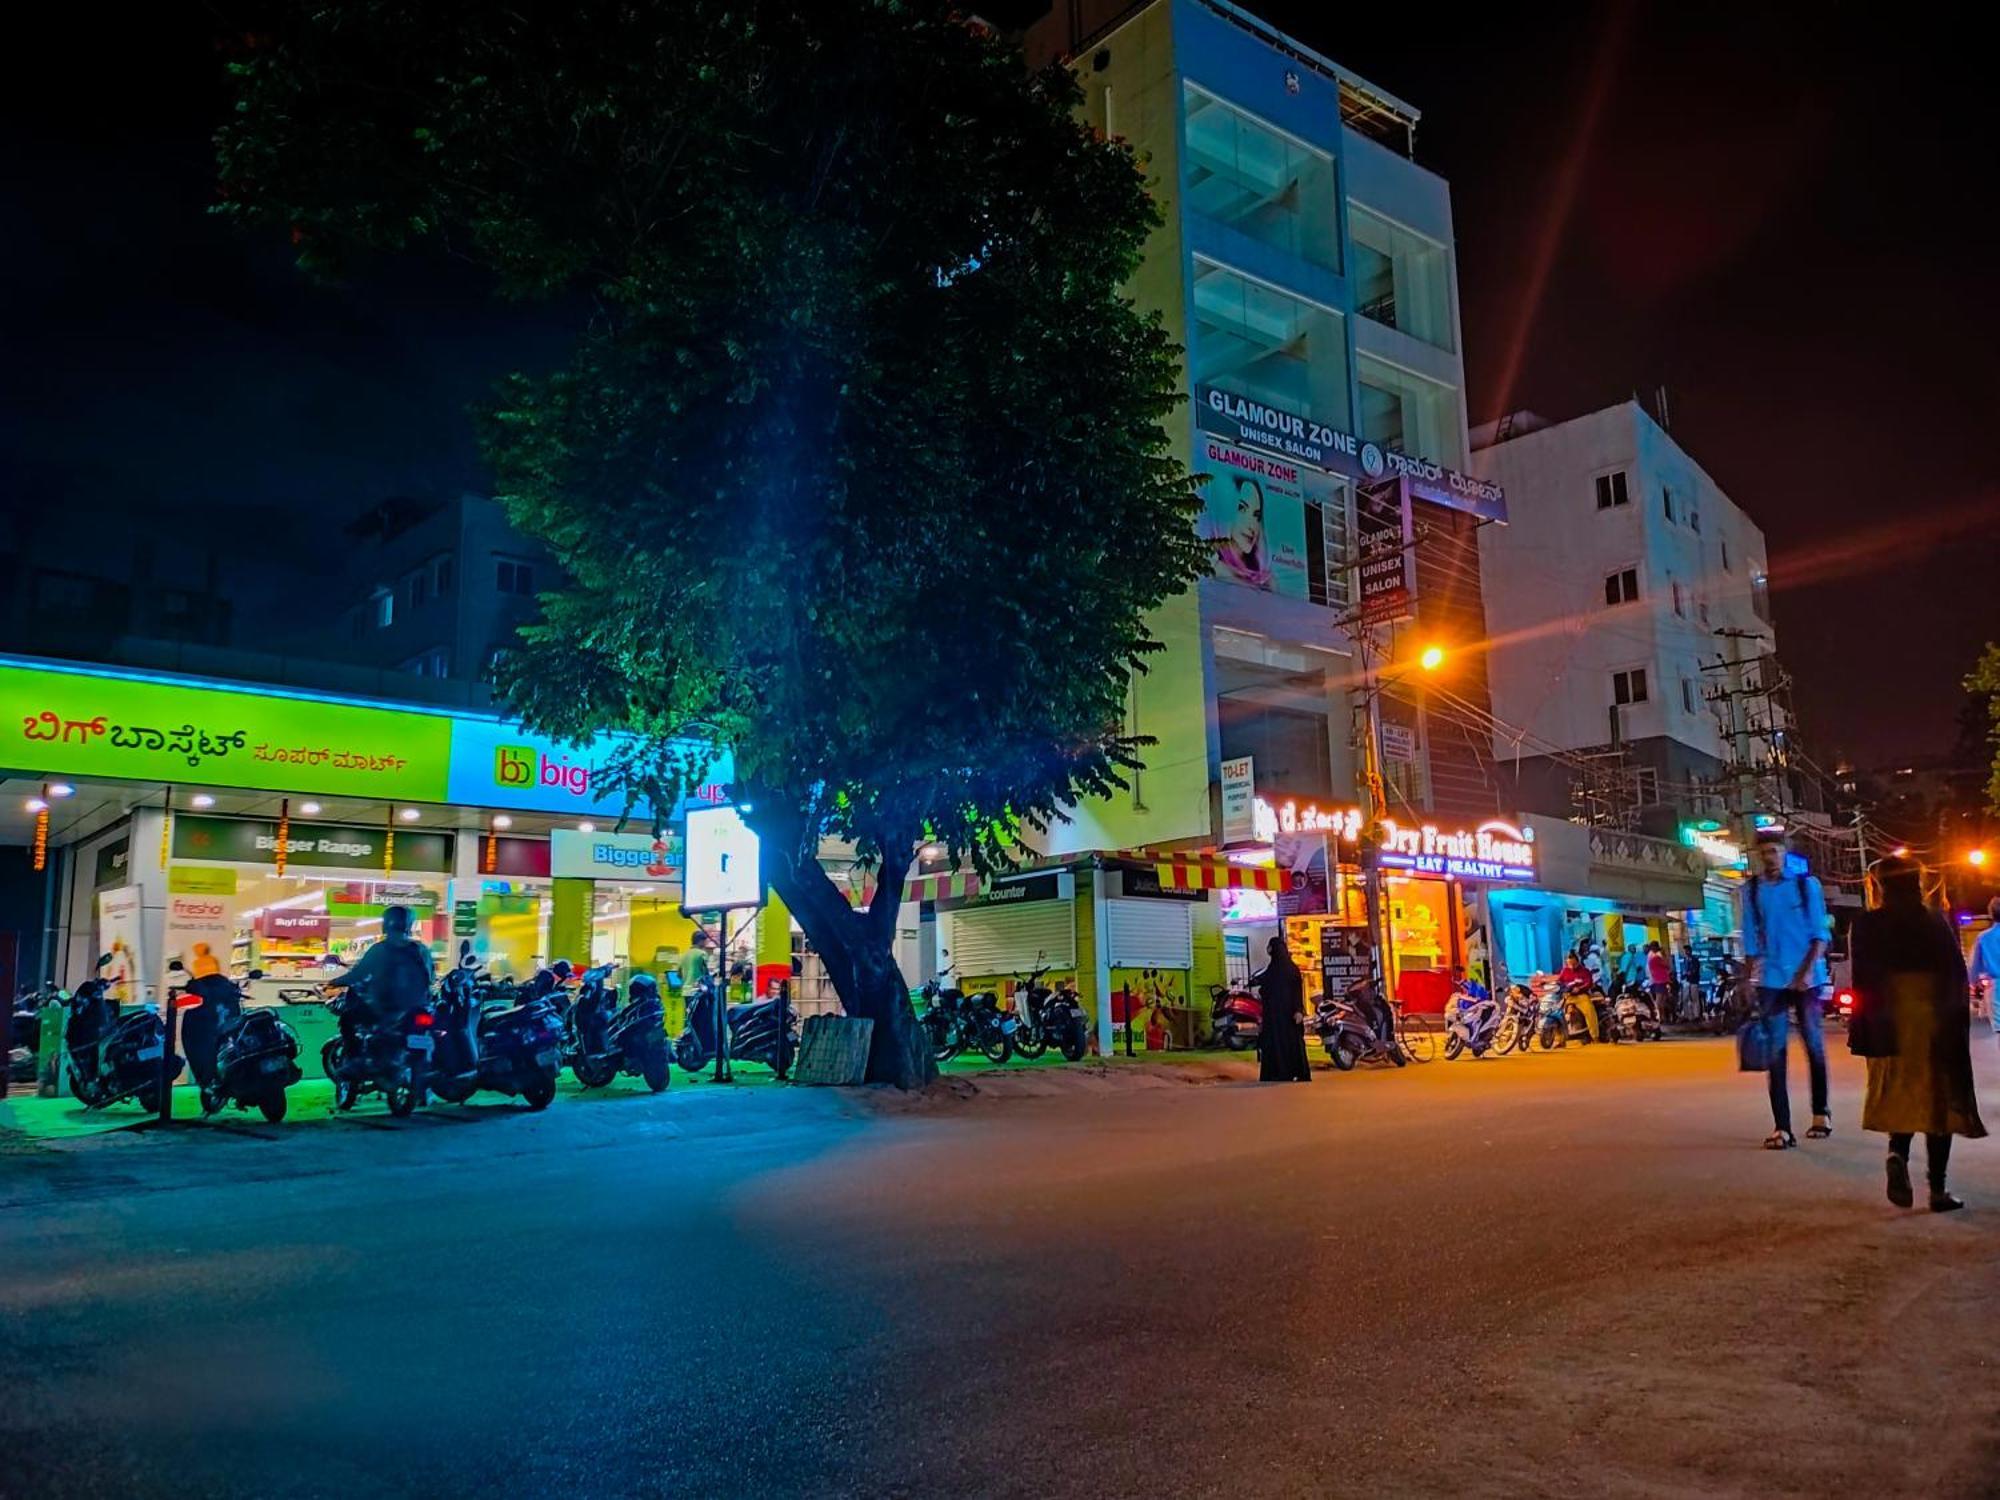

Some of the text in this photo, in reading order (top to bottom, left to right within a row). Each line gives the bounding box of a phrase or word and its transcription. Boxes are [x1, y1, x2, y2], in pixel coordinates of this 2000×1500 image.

[1208, 390, 1357, 456] GLAMOUR ZONE
[1240, 424, 1321, 461] UNISEX SALON
[1208, 445, 1298, 483] GLAMOUR ZONE
[1362, 557, 1402, 577] UNISEX
[1365, 576, 1401, 595] SALON
[1223, 761, 1249, 779] TO-LET
[317, 839, 373, 857] Range
[1380, 819, 1420, 856] Dry
[1422, 825, 1475, 858] Fruit
[1477, 832, 1532, 865] House
[1416, 856, 1504, 878] EAT HEALTHY
[989, 886, 1026, 900] counter
